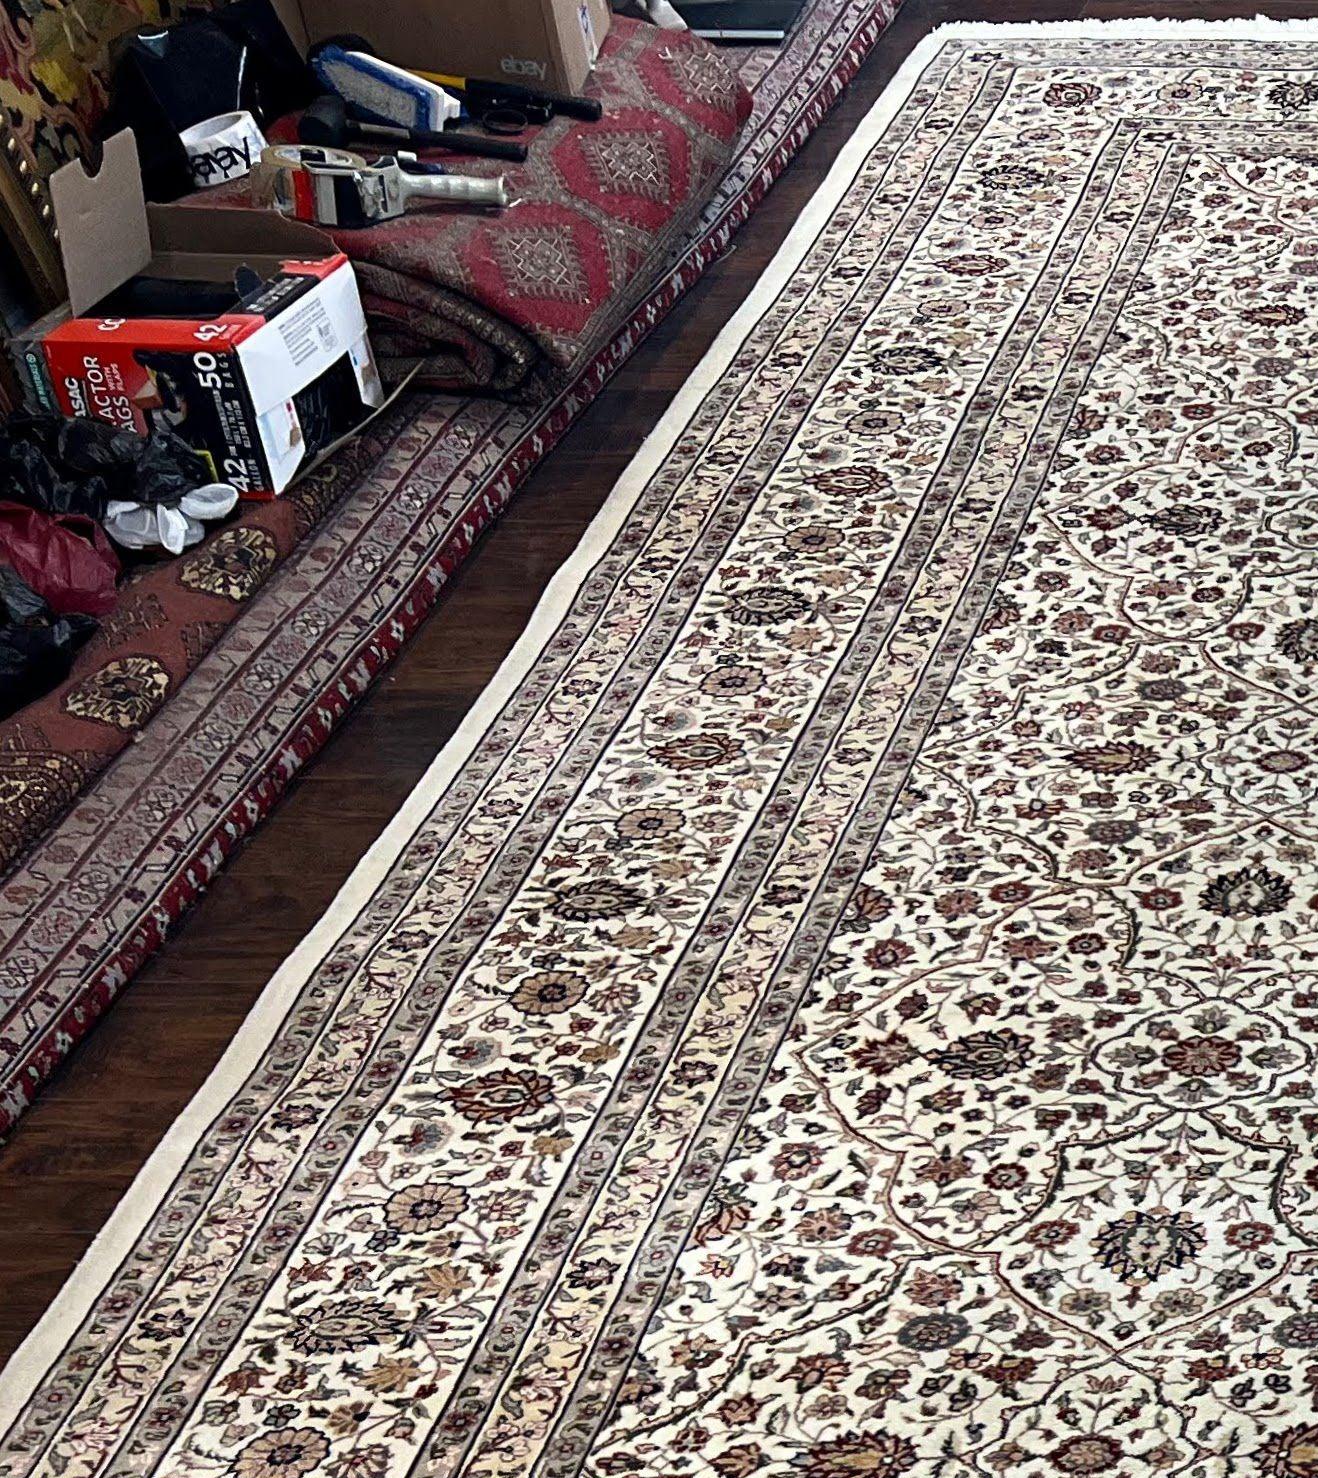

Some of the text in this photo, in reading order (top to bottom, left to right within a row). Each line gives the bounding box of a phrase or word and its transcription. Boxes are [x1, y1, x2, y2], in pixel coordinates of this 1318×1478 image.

[501, 55, 547, 81] ebay
[193, 352, 222, 390] 50
[217, 352, 235, 389] BAGS
[83, 356, 116, 425] ACTOR
[224, 458, 252, 492] 42
